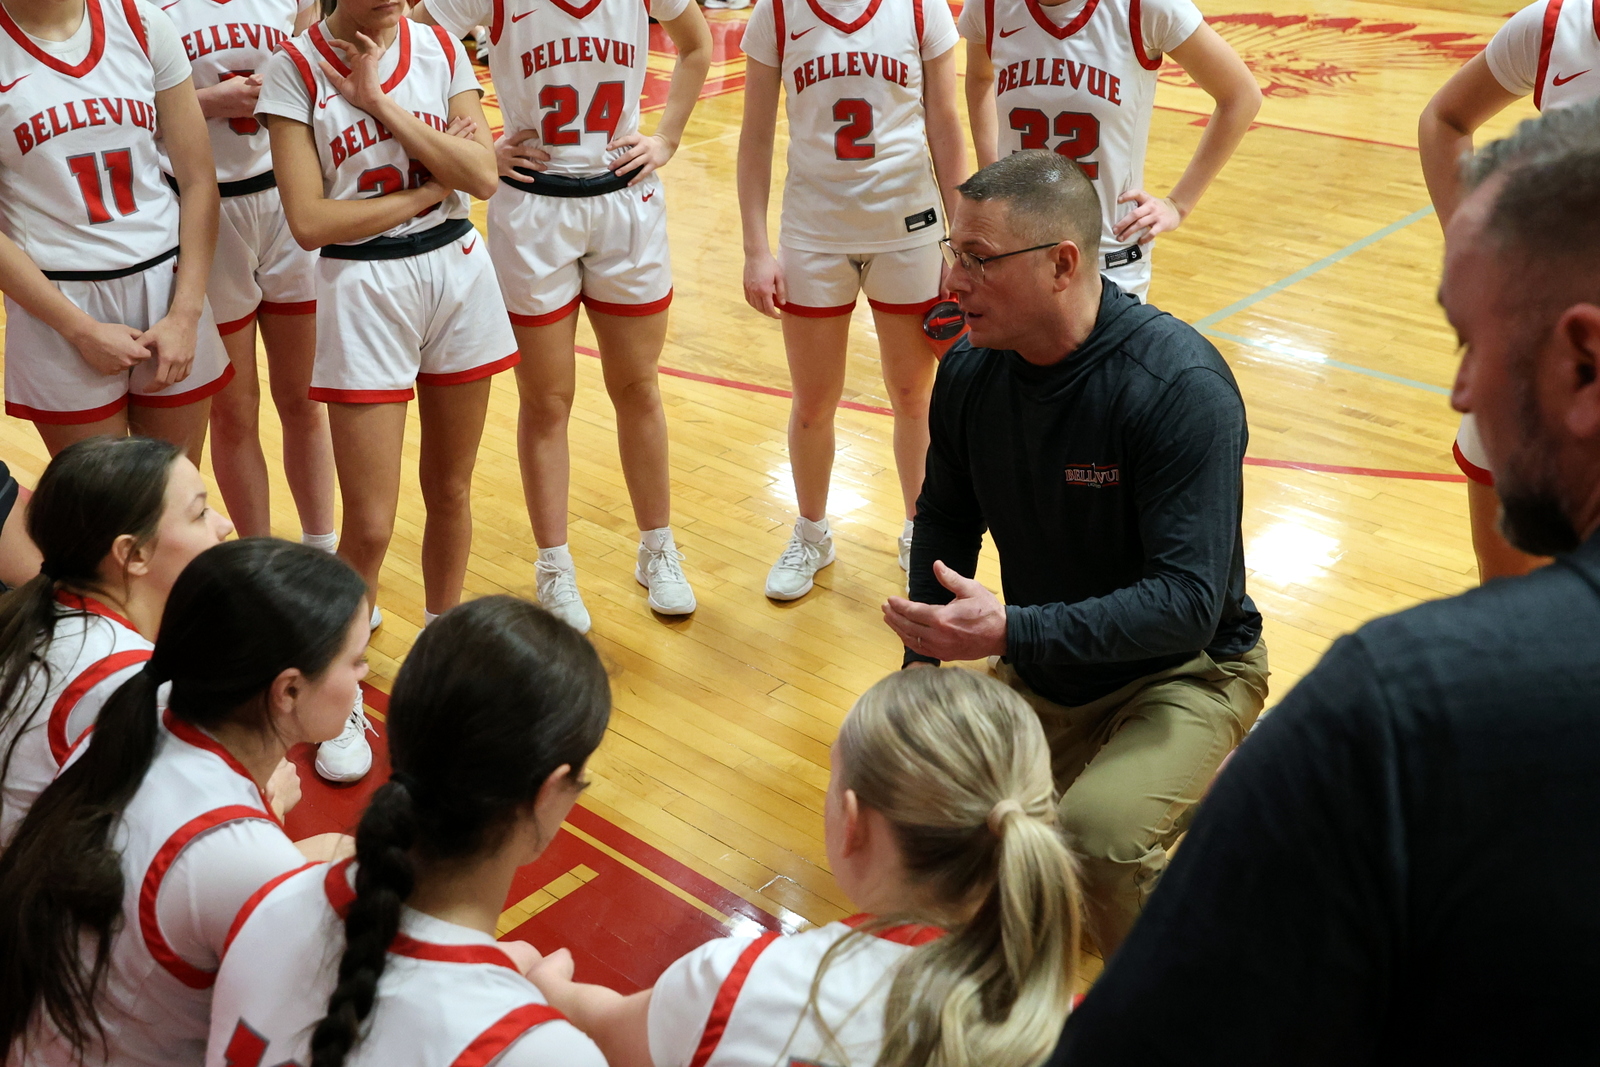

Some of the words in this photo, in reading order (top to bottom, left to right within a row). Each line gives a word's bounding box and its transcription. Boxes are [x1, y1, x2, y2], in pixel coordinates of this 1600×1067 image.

[181, 23, 289, 62] ELLEVU
[793, 51, 908, 95] BELLEVUE
[997, 58, 1122, 107] BELLEVUE
[538, 81, 625, 147] 24
[832, 98, 875, 161] 2
[1008, 107, 1100, 181] 32
[66, 147, 140, 225] 11
[927, 213, 934, 221] S
[1131, 251, 1138, 259] S
